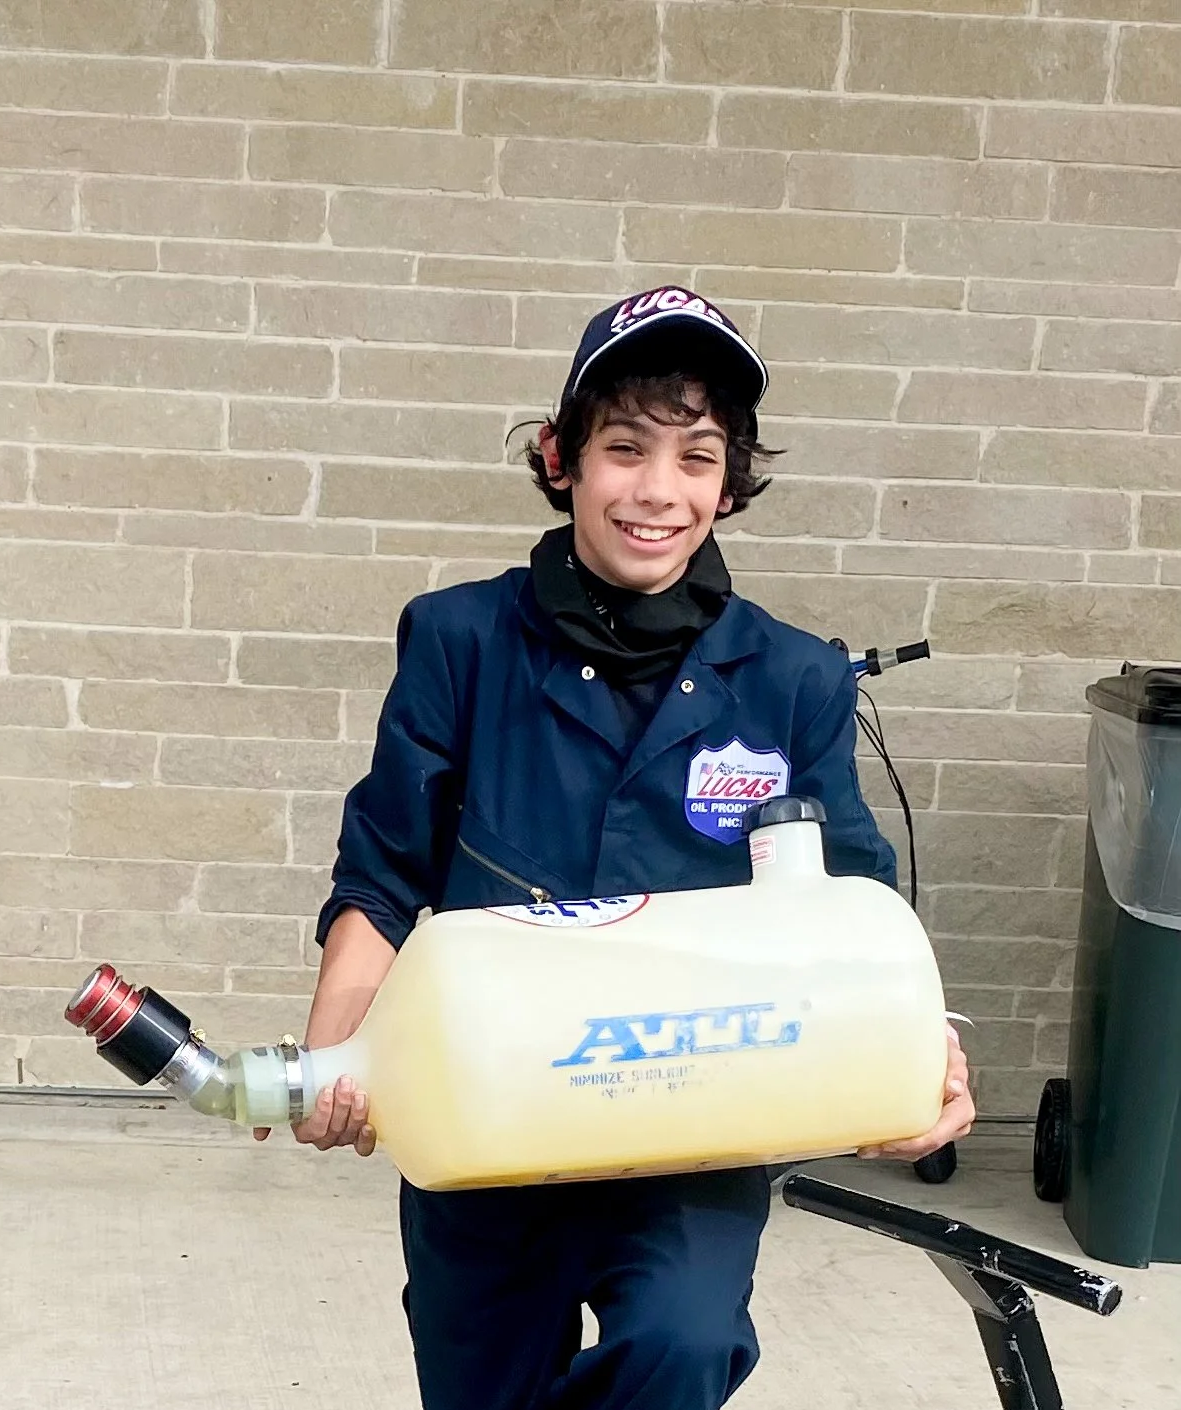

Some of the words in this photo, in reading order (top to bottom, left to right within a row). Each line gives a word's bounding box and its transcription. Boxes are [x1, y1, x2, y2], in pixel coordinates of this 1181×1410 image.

[696, 775, 779, 798] LUCAS
[690, 801, 708, 813] OIL
[710, 802, 752, 814] PROD
[551, 1001, 803, 1068] ATL
